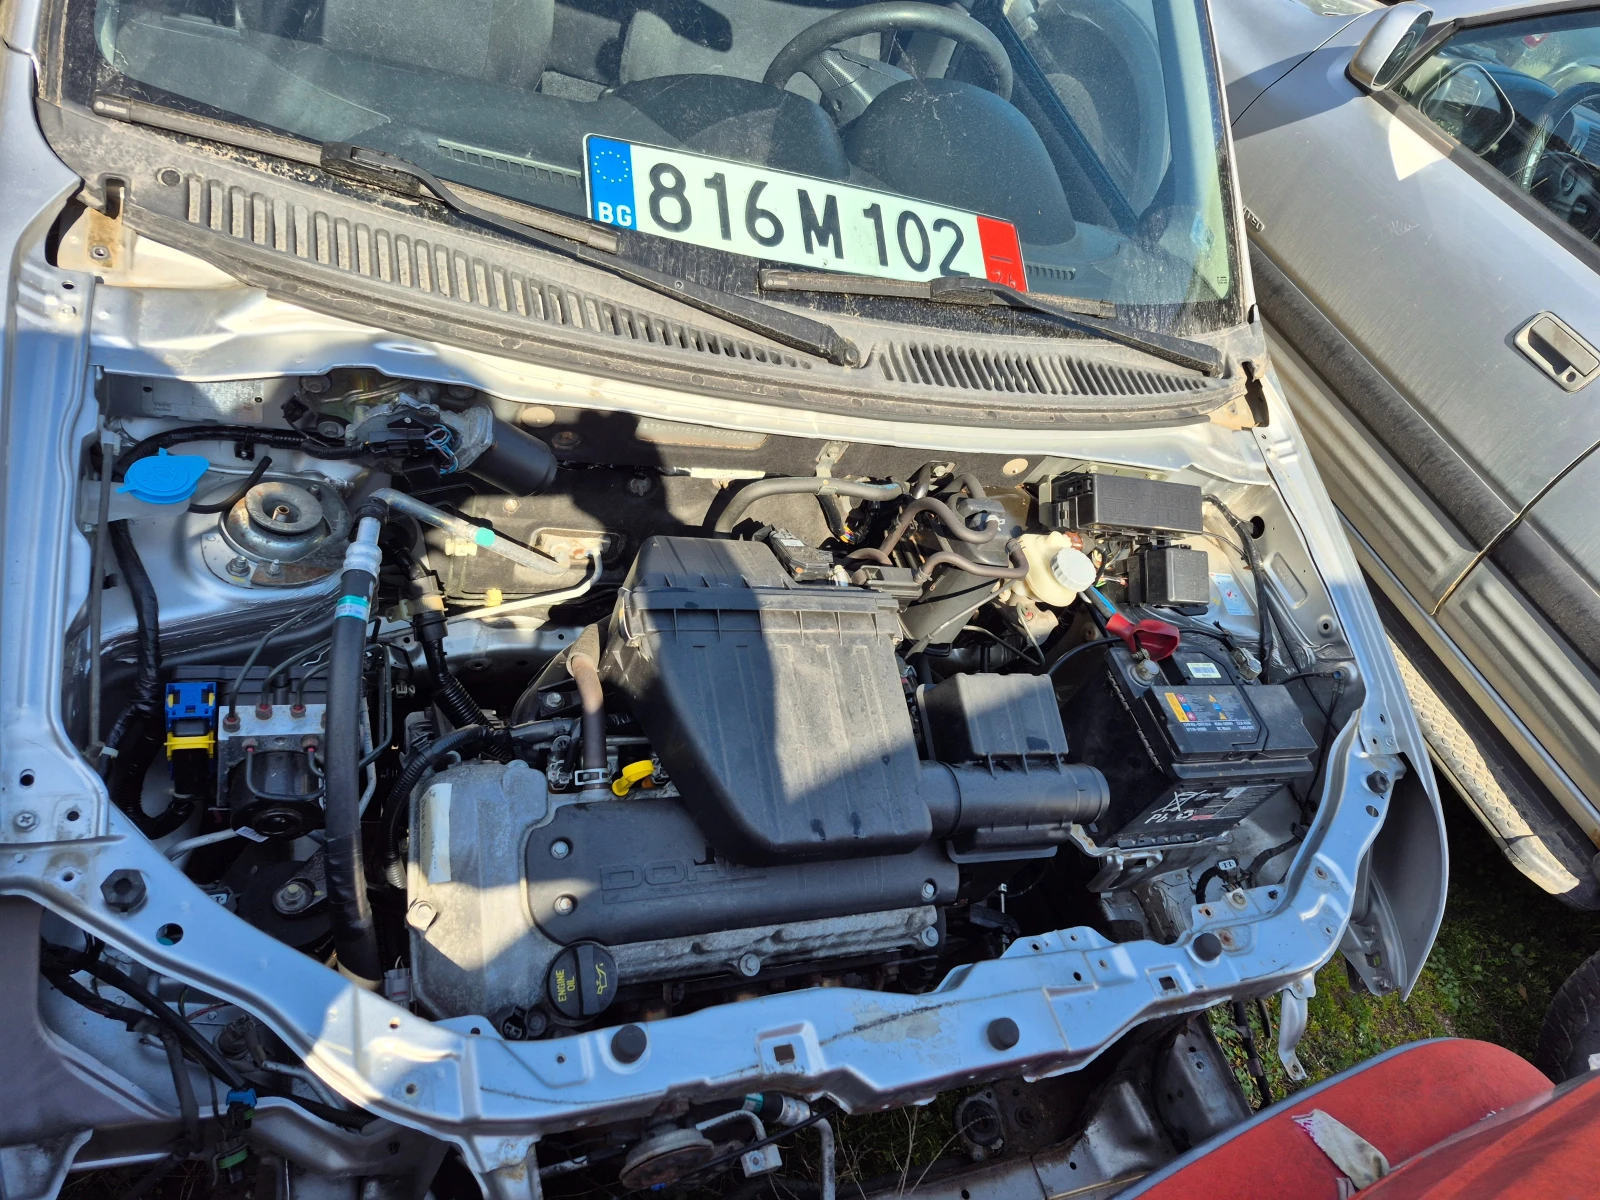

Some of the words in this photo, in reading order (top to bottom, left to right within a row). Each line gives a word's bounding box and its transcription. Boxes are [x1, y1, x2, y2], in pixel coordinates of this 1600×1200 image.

[598, 202, 632, 227] BG
[1144, 812, 1169, 824] Pb
[555, 969, 567, 1002] ENGINE
[566, 976, 576, 992] OIL
